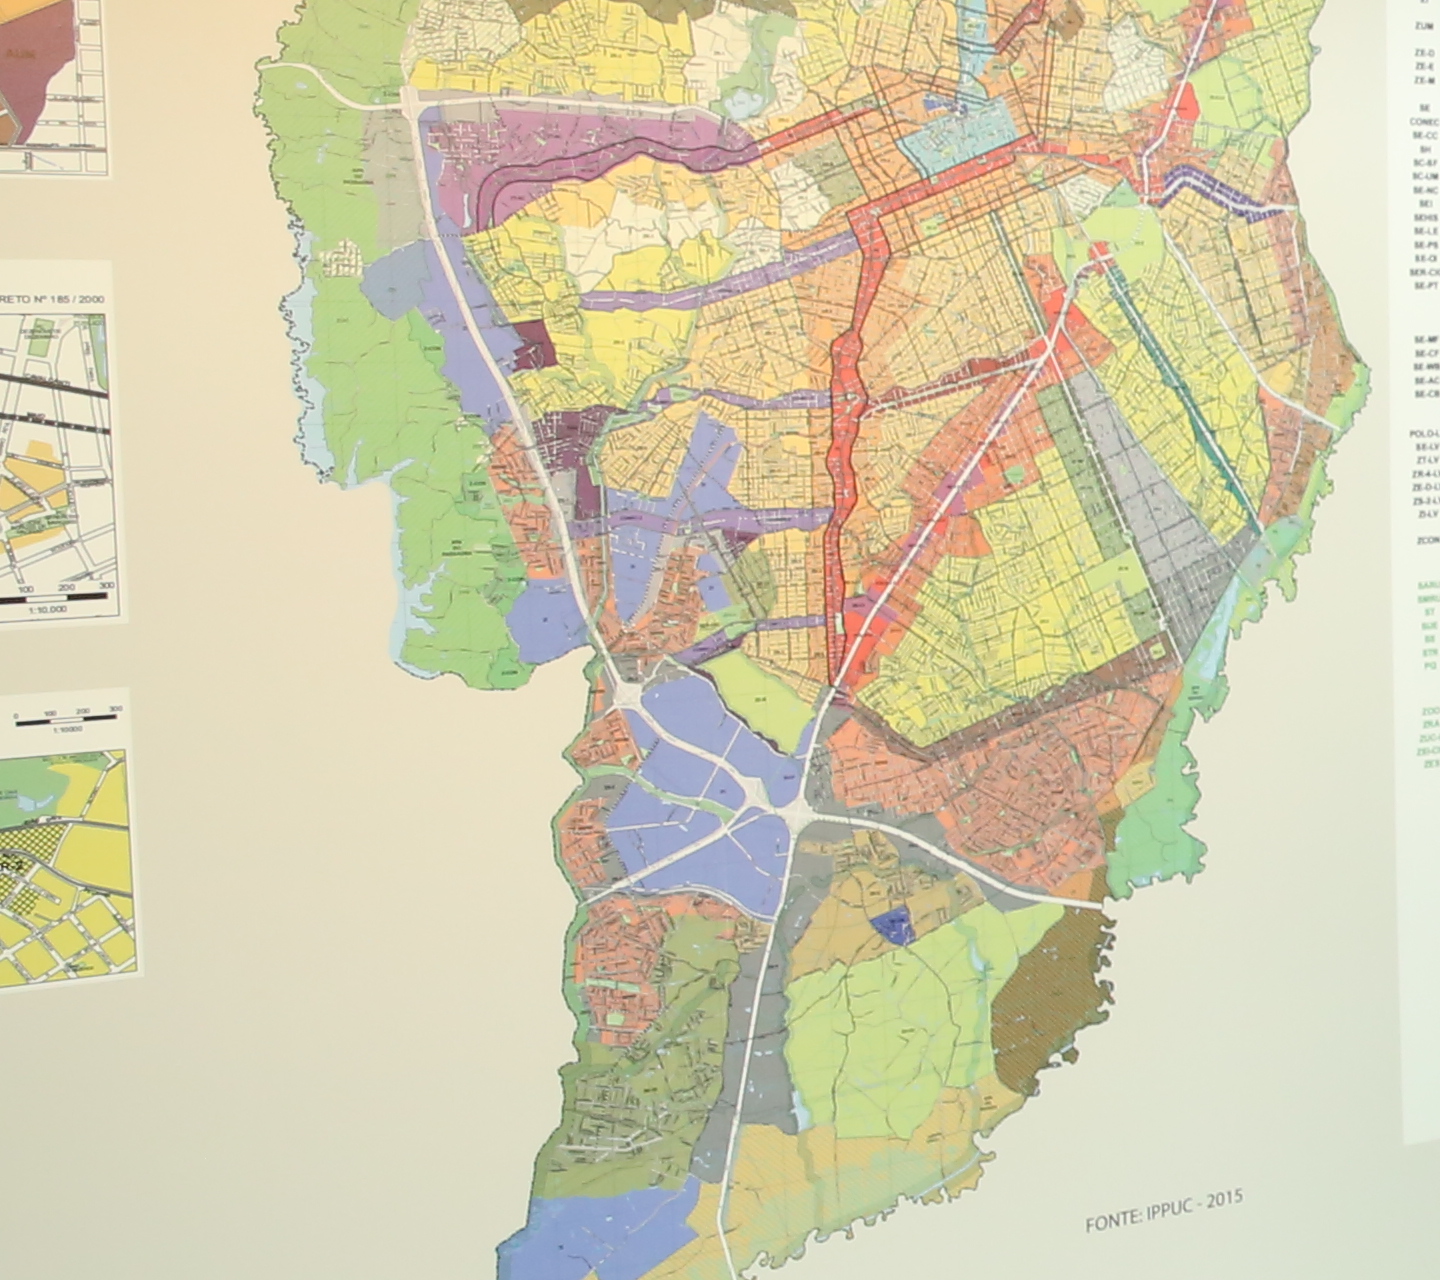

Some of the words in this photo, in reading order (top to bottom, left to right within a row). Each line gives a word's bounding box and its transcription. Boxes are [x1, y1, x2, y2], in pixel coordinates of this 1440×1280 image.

[1086, 1208, 1143, 1233] FONTE:
[1147, 1197, 1193, 1221] IPPUC
[1207, 1187, 1243, 1209] 2015
